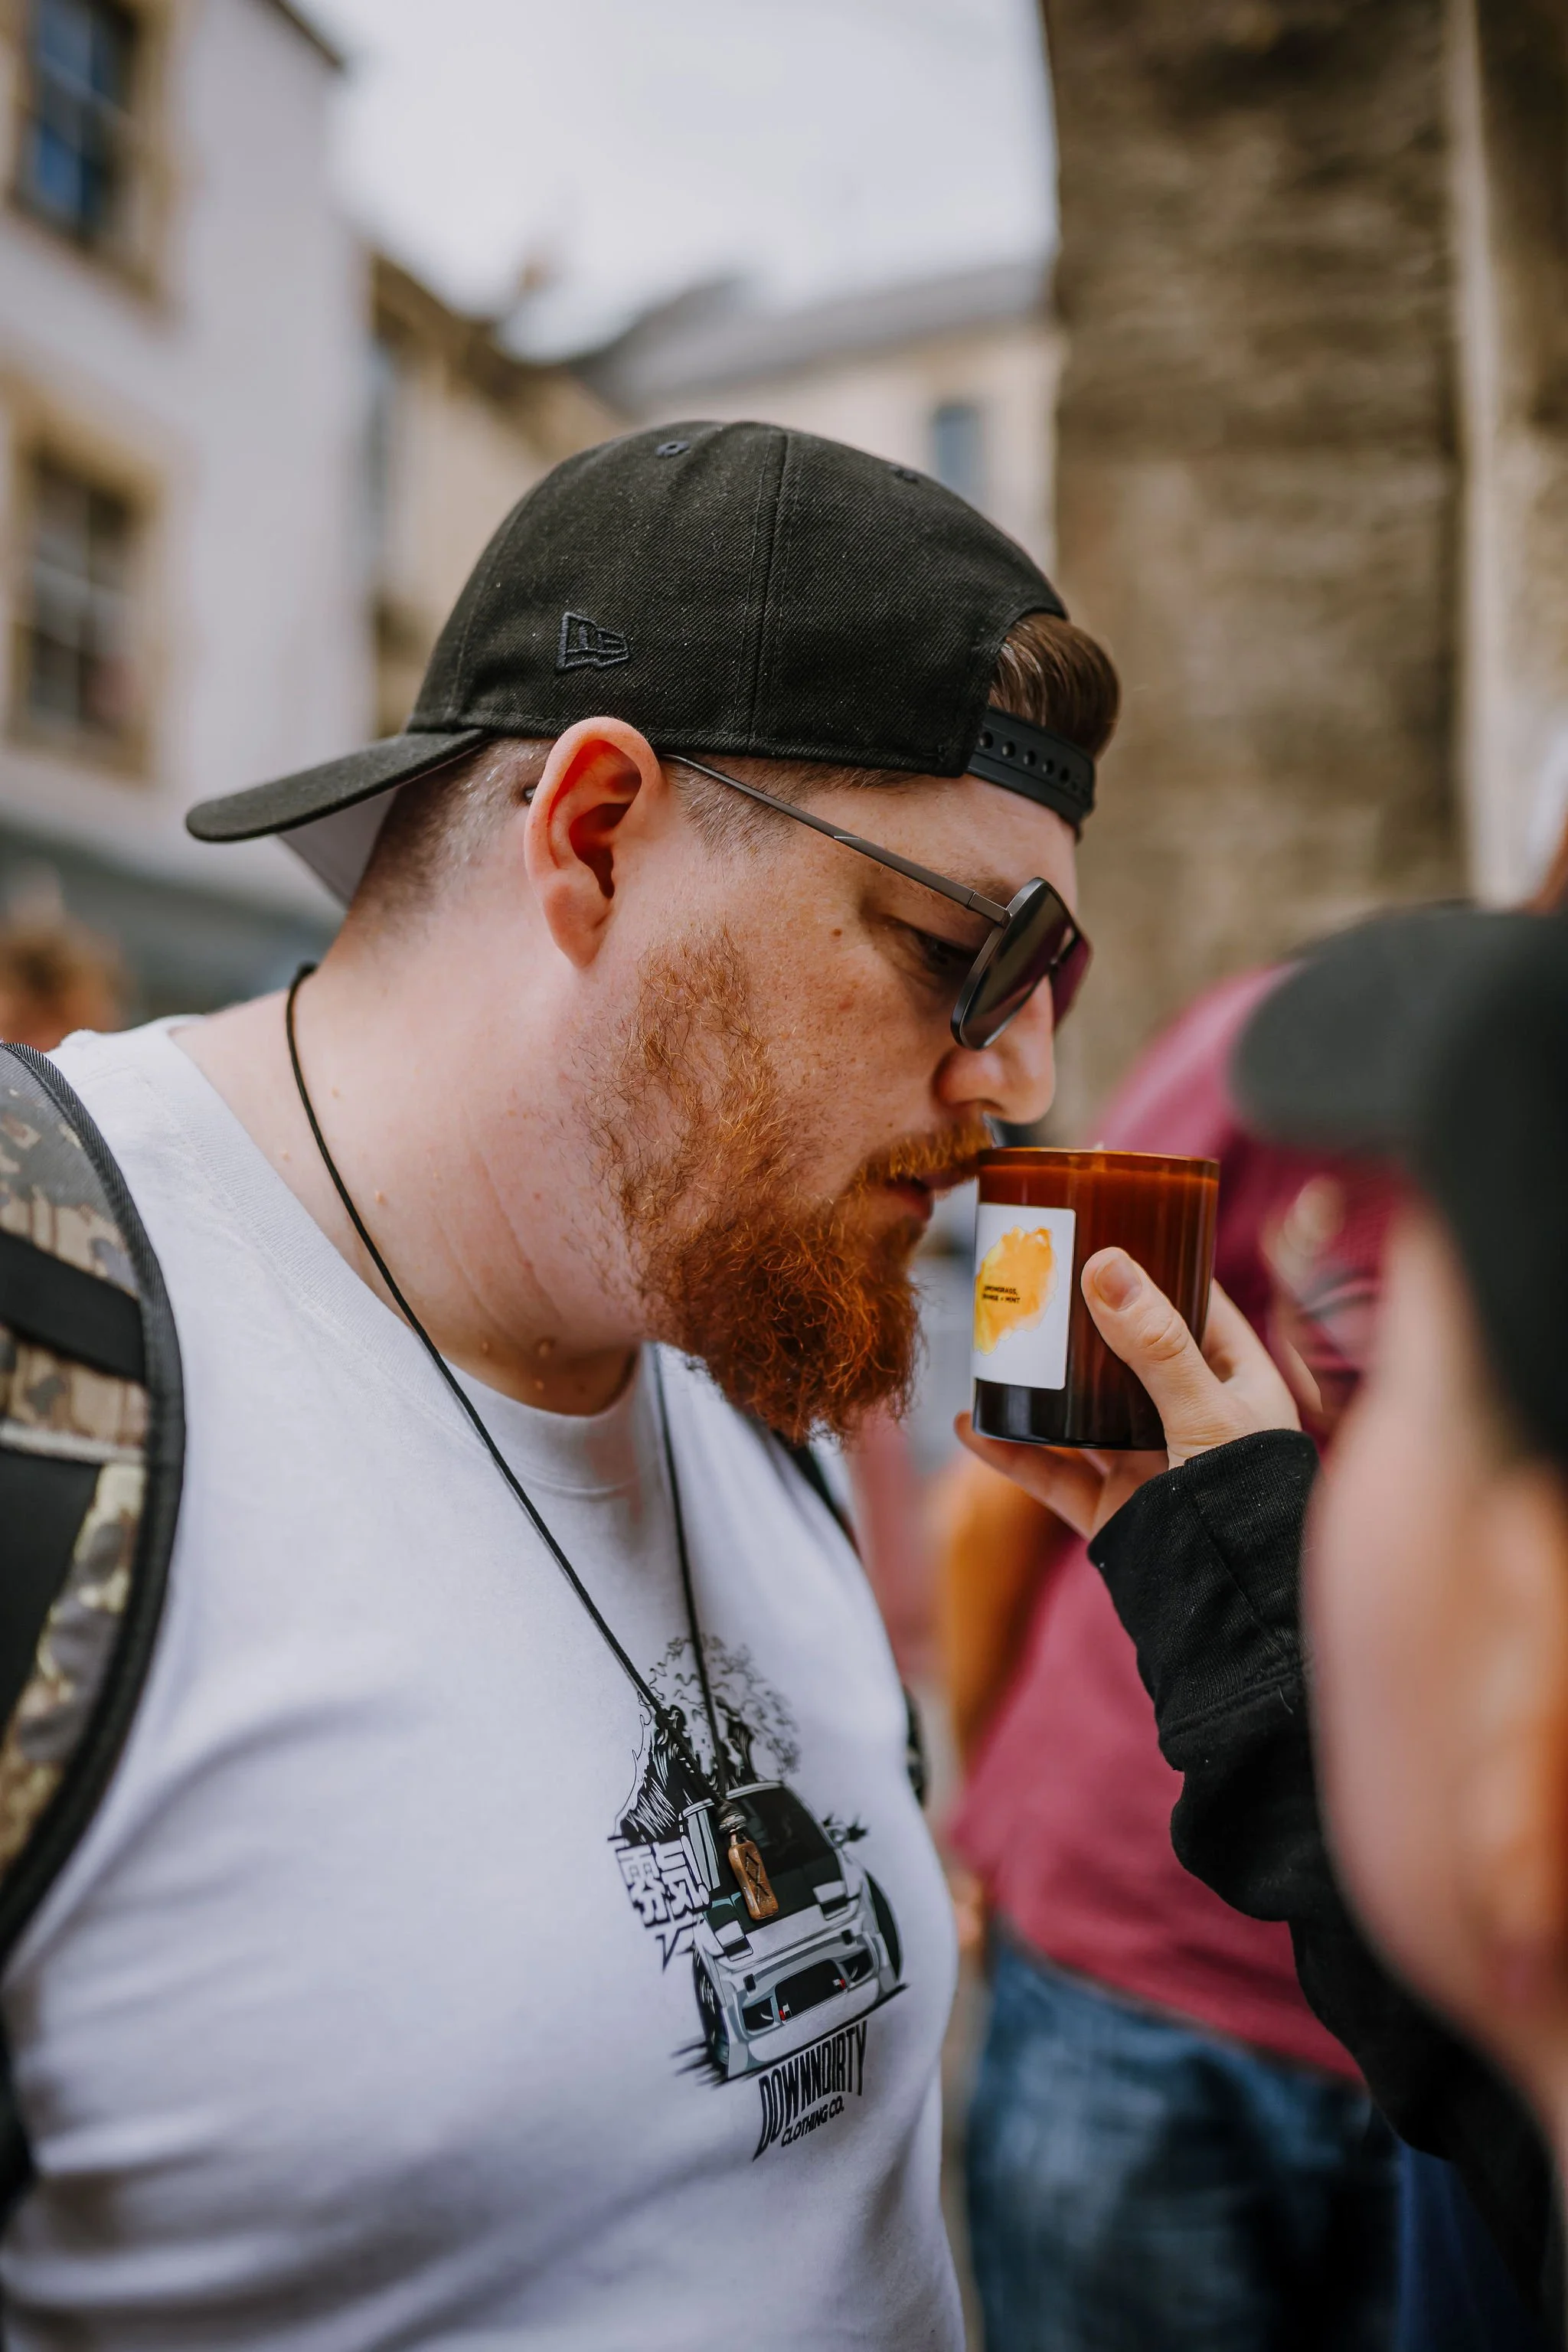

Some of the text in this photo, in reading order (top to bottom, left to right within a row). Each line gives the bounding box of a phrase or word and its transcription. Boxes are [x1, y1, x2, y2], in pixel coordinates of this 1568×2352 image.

[753, 2020, 867, 2162] DOWNNDIRTY
[781, 2096, 844, 2147] CLOTHING CO.
